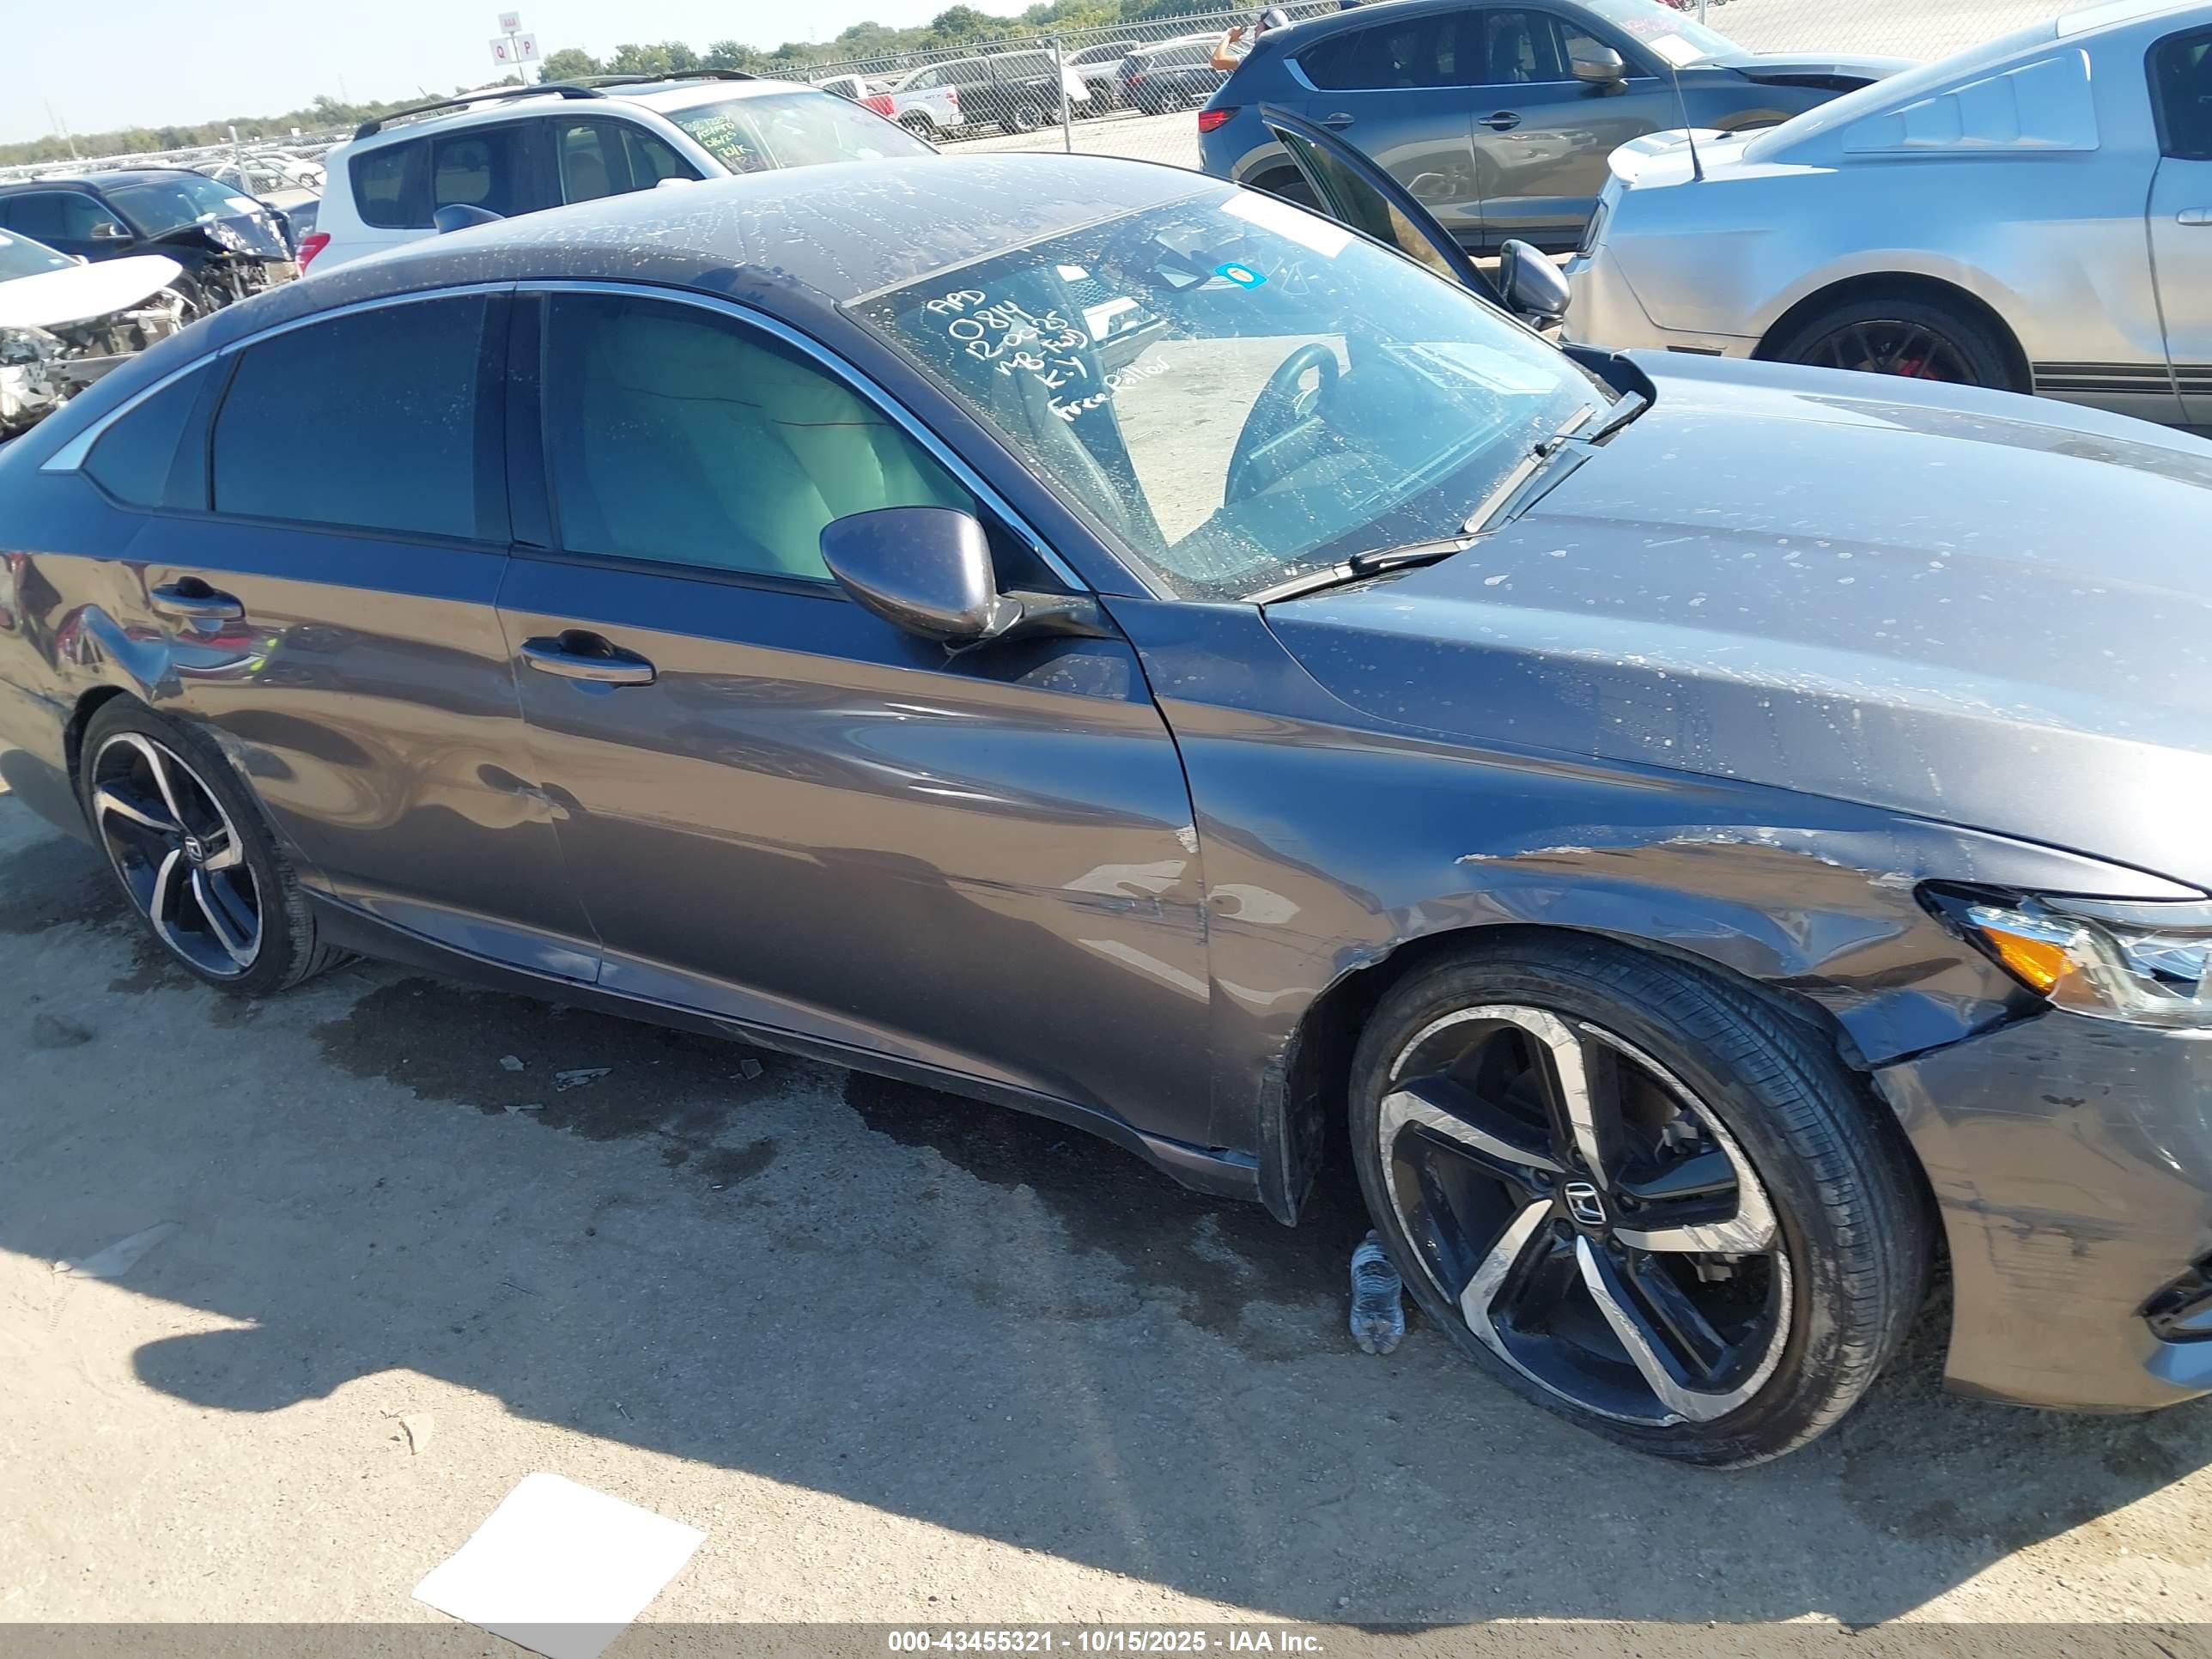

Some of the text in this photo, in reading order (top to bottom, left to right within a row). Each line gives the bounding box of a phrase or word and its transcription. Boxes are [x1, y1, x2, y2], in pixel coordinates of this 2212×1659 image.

[496, 45, 506, 58] Q
[524, 40, 531, 55] P
[927, 290, 986, 315] APD
[949, 301, 1034, 340] 0814
[965, 341, 1003, 361] 12
[1031, 311, 1068, 330] 25
